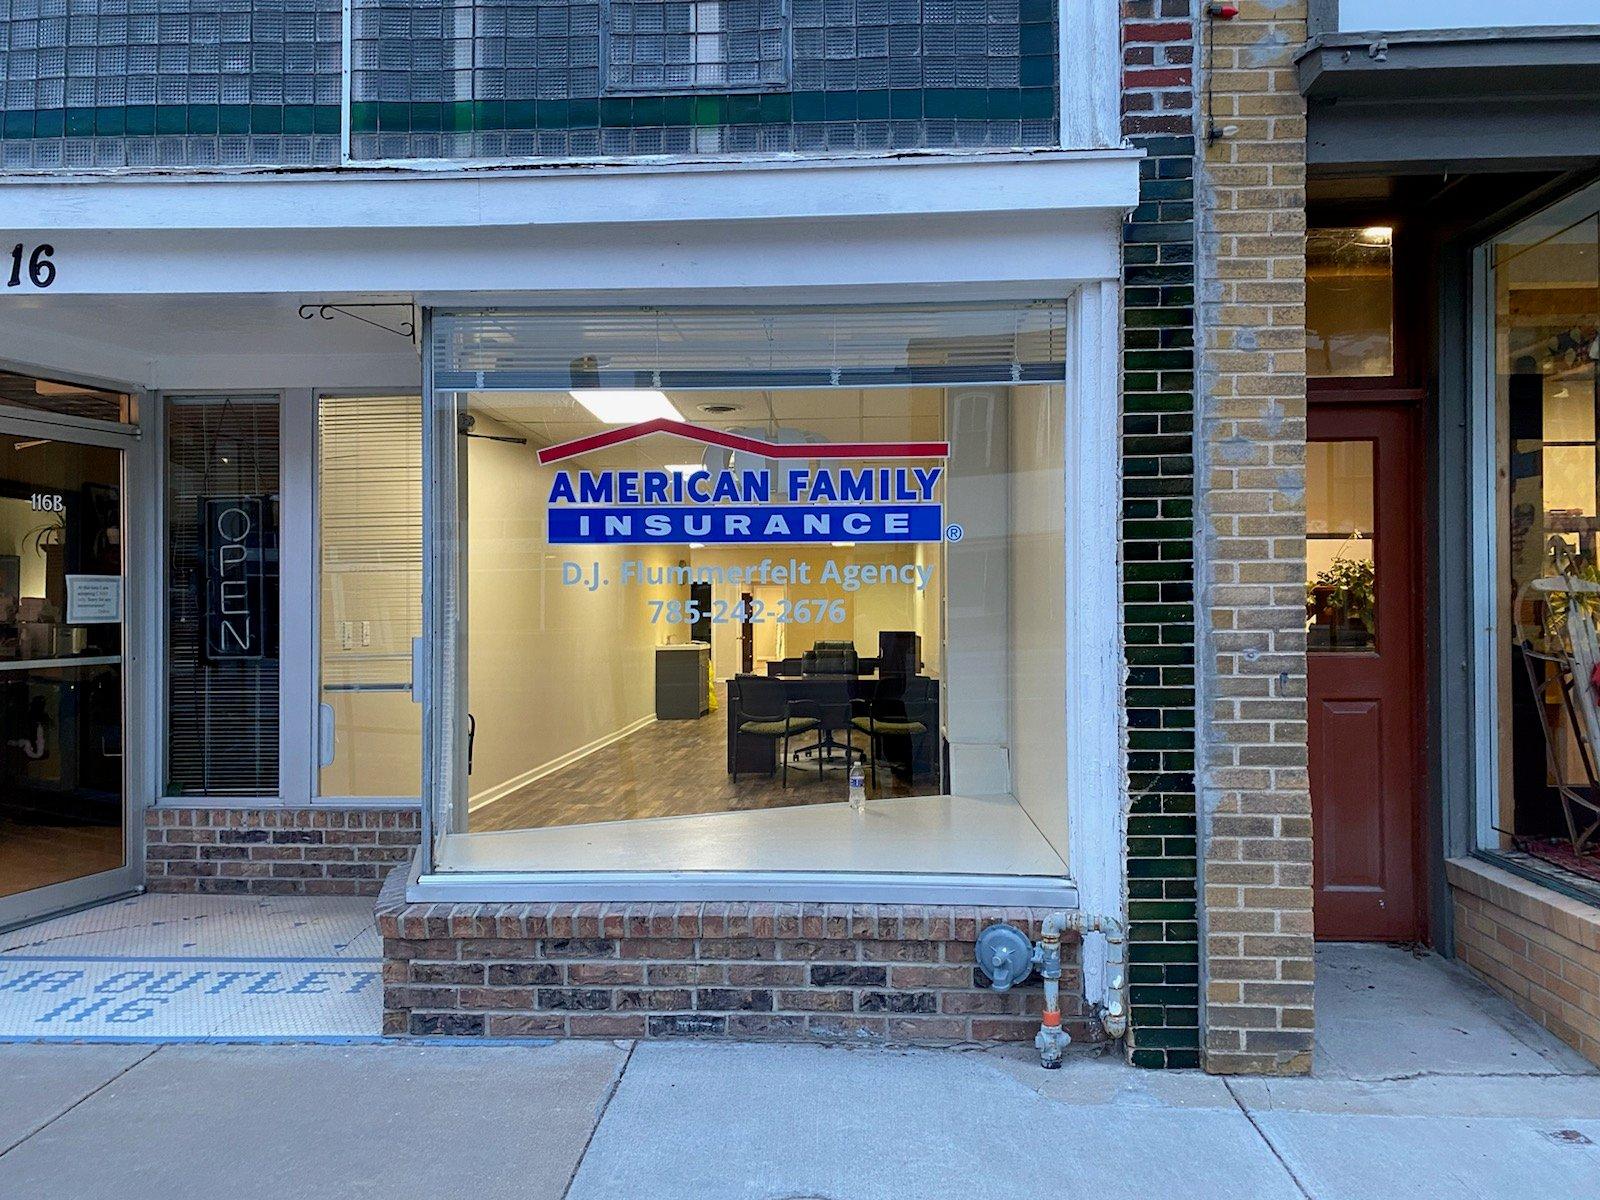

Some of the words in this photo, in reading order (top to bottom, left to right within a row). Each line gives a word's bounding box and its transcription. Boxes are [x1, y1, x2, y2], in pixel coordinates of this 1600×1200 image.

[7, 243, 56, 288] 16
[548, 469, 771, 504] AMERICAN
[788, 467, 943, 502] FAMILY
[31, 493, 64, 512] 116B
[580, 513, 910, 537] INSURANCE
[218, 508, 250, 651] OPEN
[562, 561, 609, 592] D.J.
[620, 558, 811, 586] Flummerfelt
[820, 559, 934, 592] Agency
[648, 598, 846, 624] 785-242-2676
[94, 969, 382, 994] OUTLET
[34, 997, 170, 1023] 116
